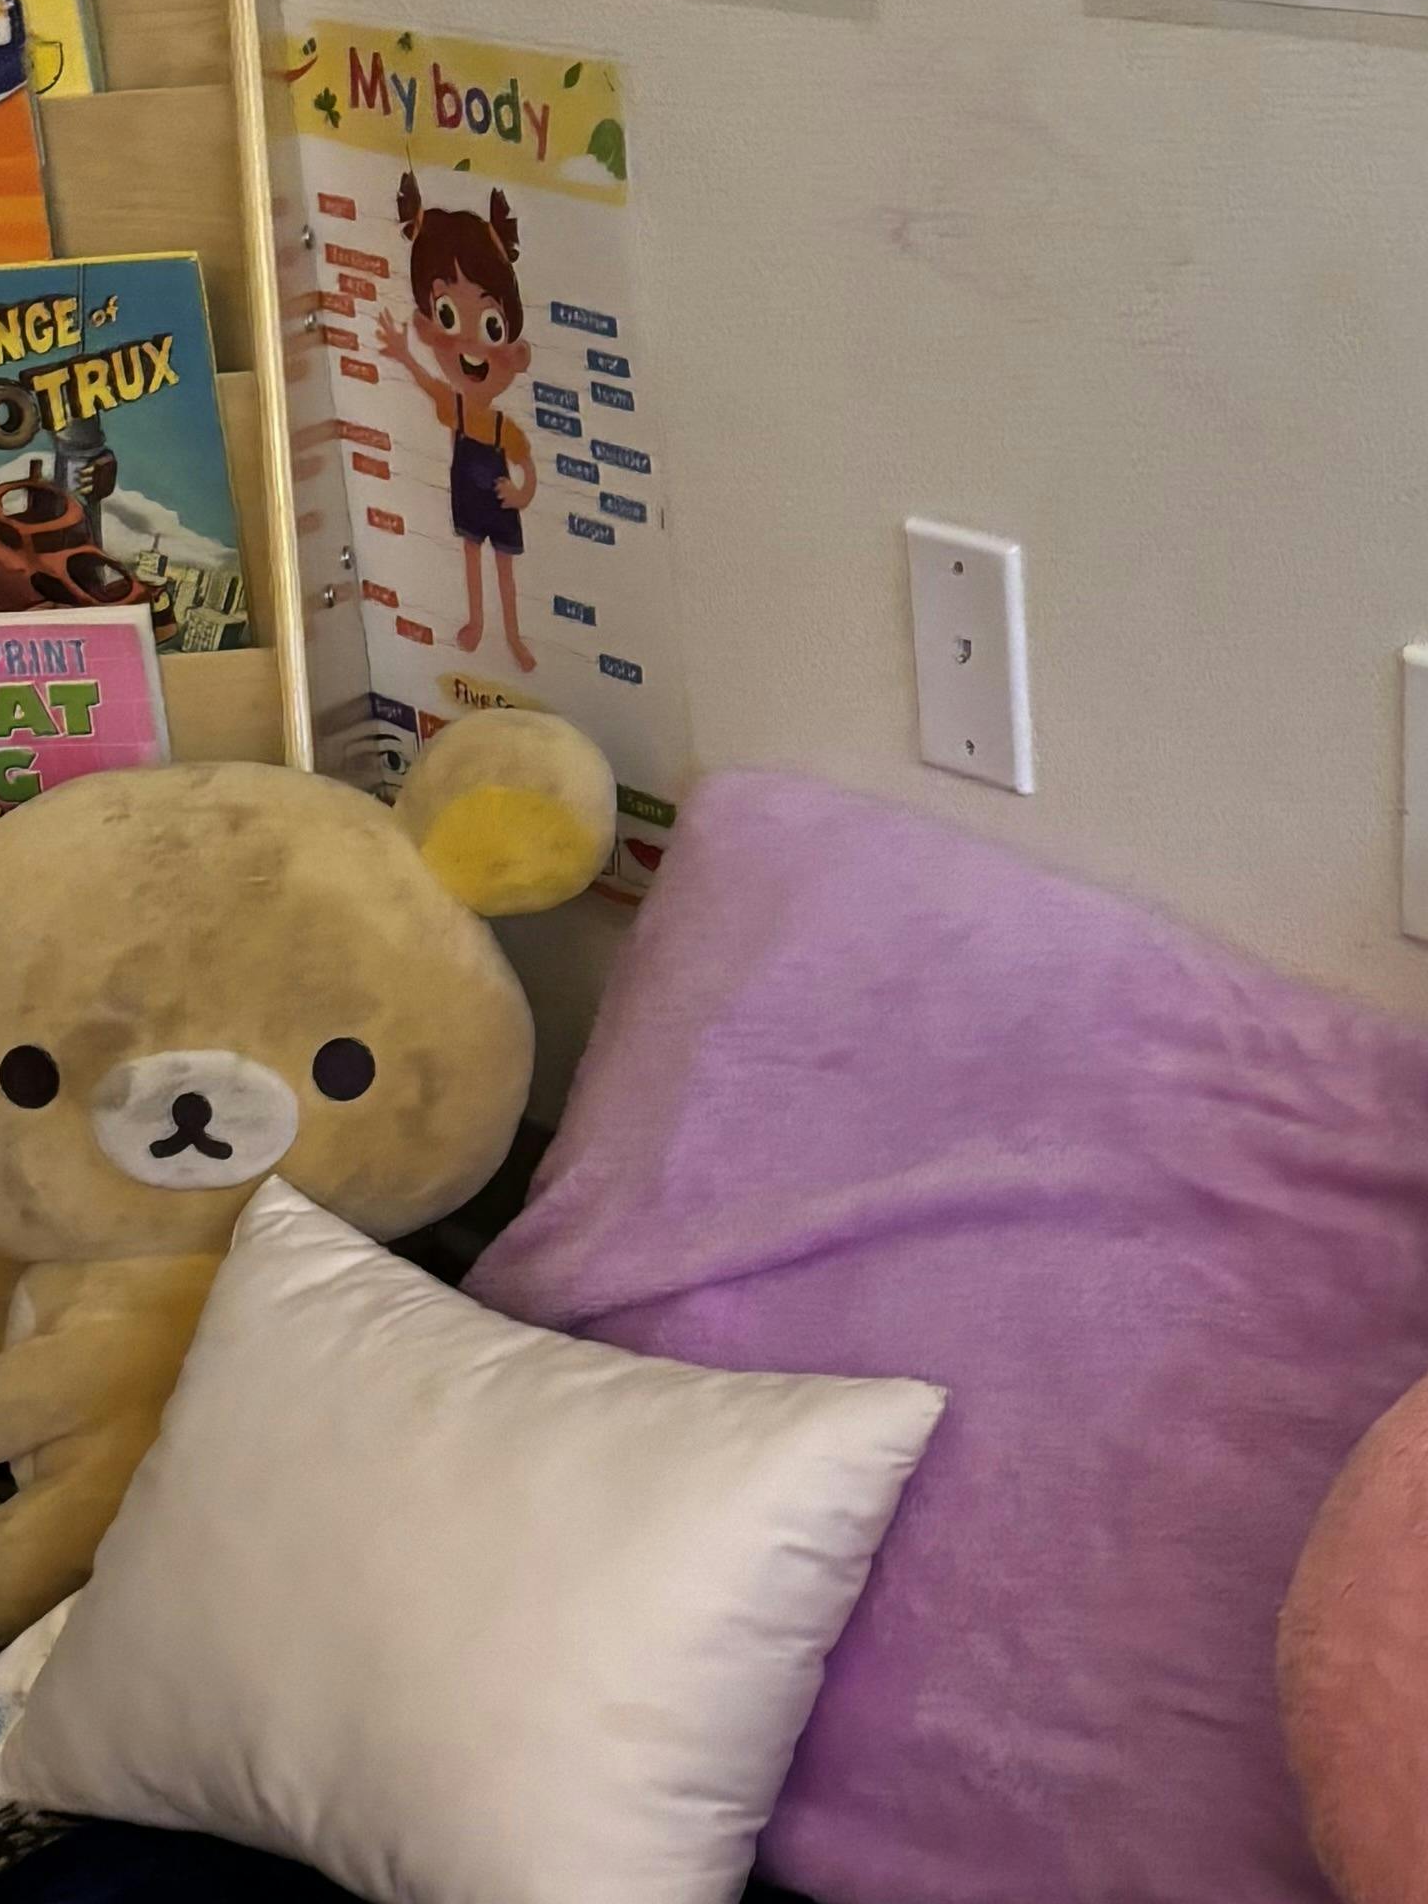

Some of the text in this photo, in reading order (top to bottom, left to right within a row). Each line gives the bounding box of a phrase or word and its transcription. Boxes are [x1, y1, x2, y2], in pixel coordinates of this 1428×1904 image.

[348, 46, 552, 162] My body
[89, 295, 120, 328] of
